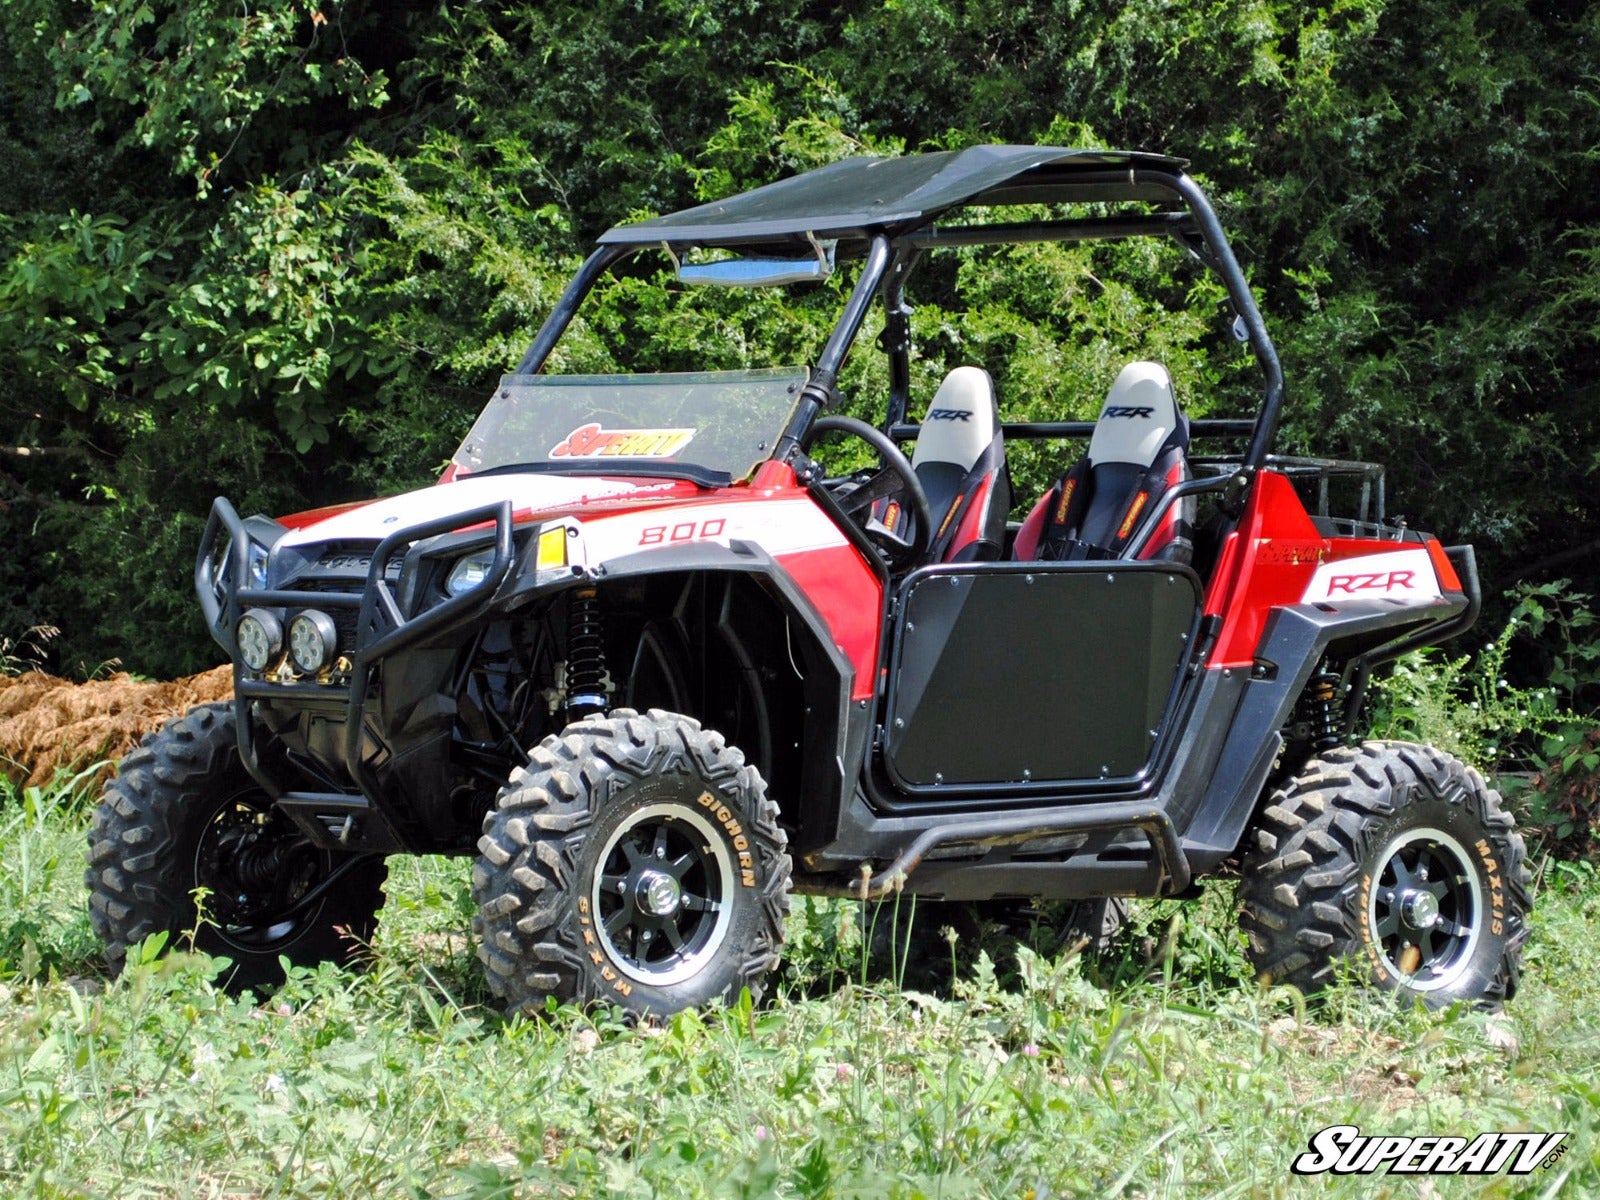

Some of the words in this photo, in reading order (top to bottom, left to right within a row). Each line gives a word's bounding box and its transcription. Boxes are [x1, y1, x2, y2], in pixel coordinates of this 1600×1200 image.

[927, 409, 974, 422] RZR
[1101, 406, 1156, 419] RZR
[638, 518, 727, 546] 800
[1326, 570, 1416, 597] RZR
[697, 790, 755, 888] BIGHORN
[1474, 838, 1504, 936] MAXXIS
[577, 896, 632, 997] MAXXIS
